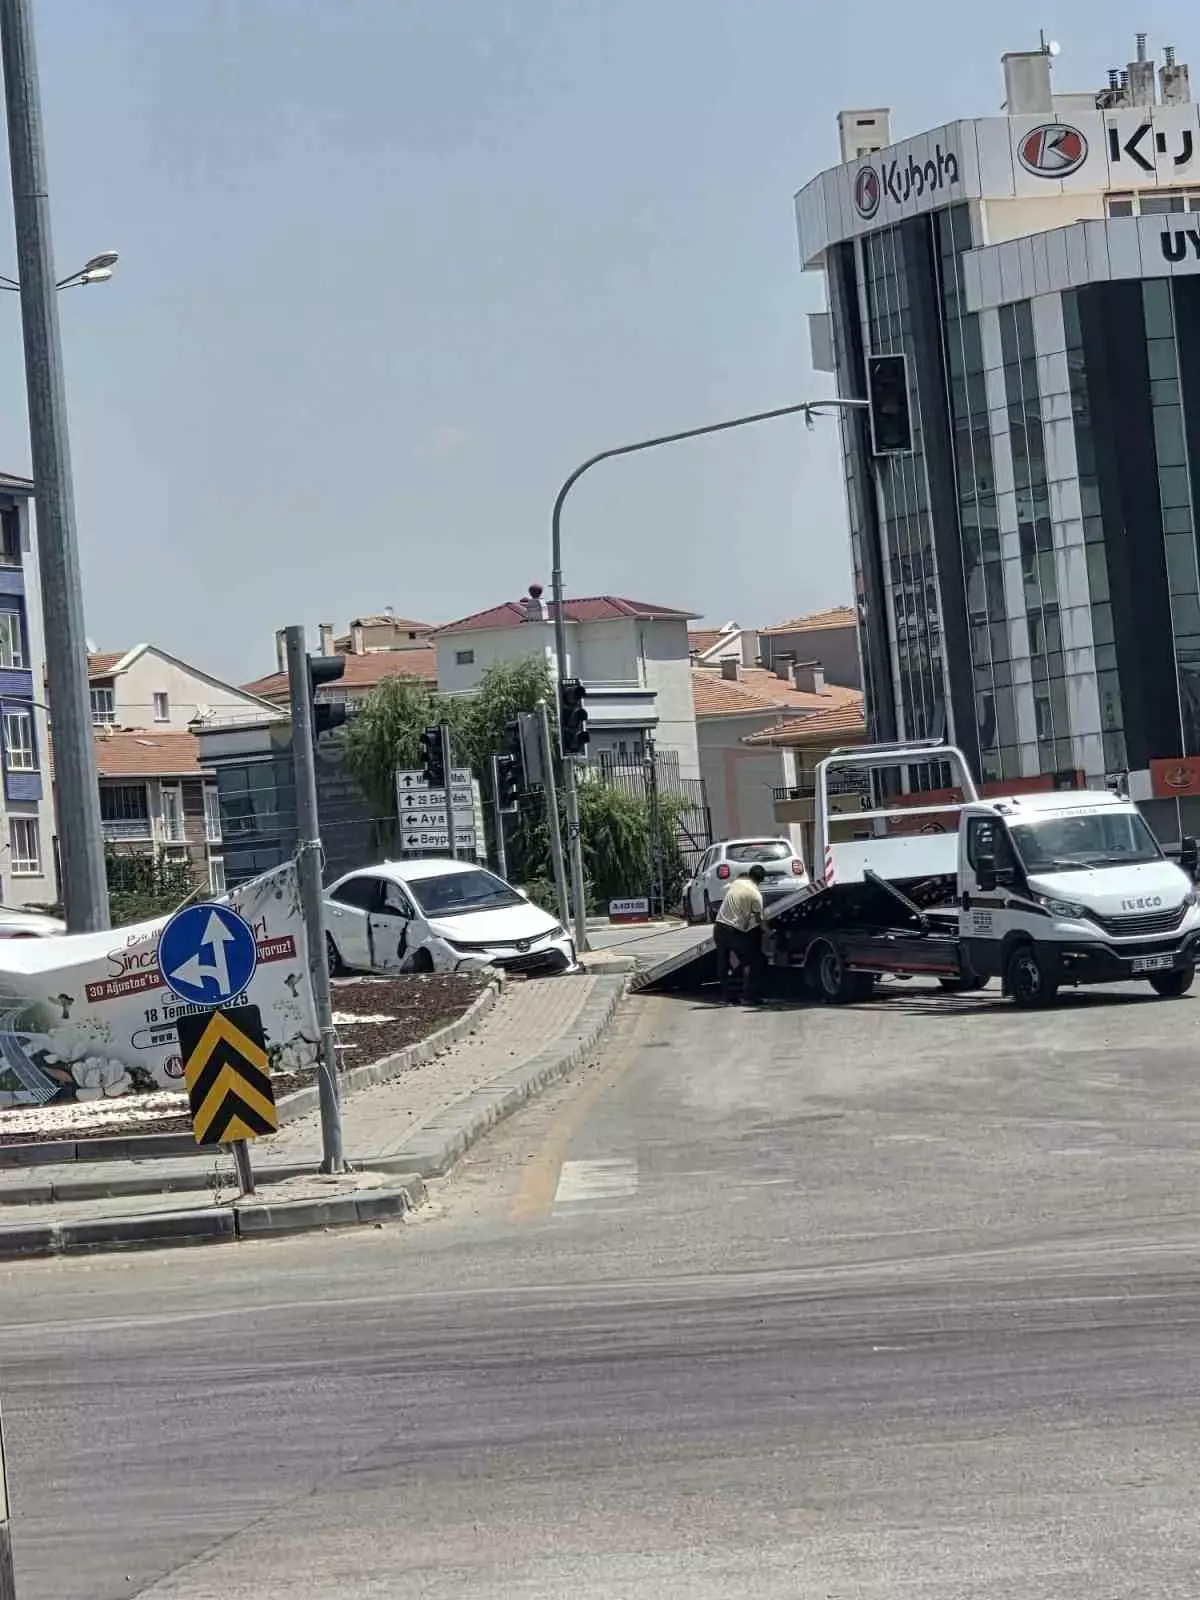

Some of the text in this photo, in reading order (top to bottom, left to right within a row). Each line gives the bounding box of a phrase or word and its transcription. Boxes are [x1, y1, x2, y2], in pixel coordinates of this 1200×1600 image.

[881, 144, 960, 205] Kubota
[420, 814, 446, 825] Aya
[107, 947, 159, 978] Sinca
[89, 985, 104, 998] 30
[144, 1008, 159, 1023] 18
